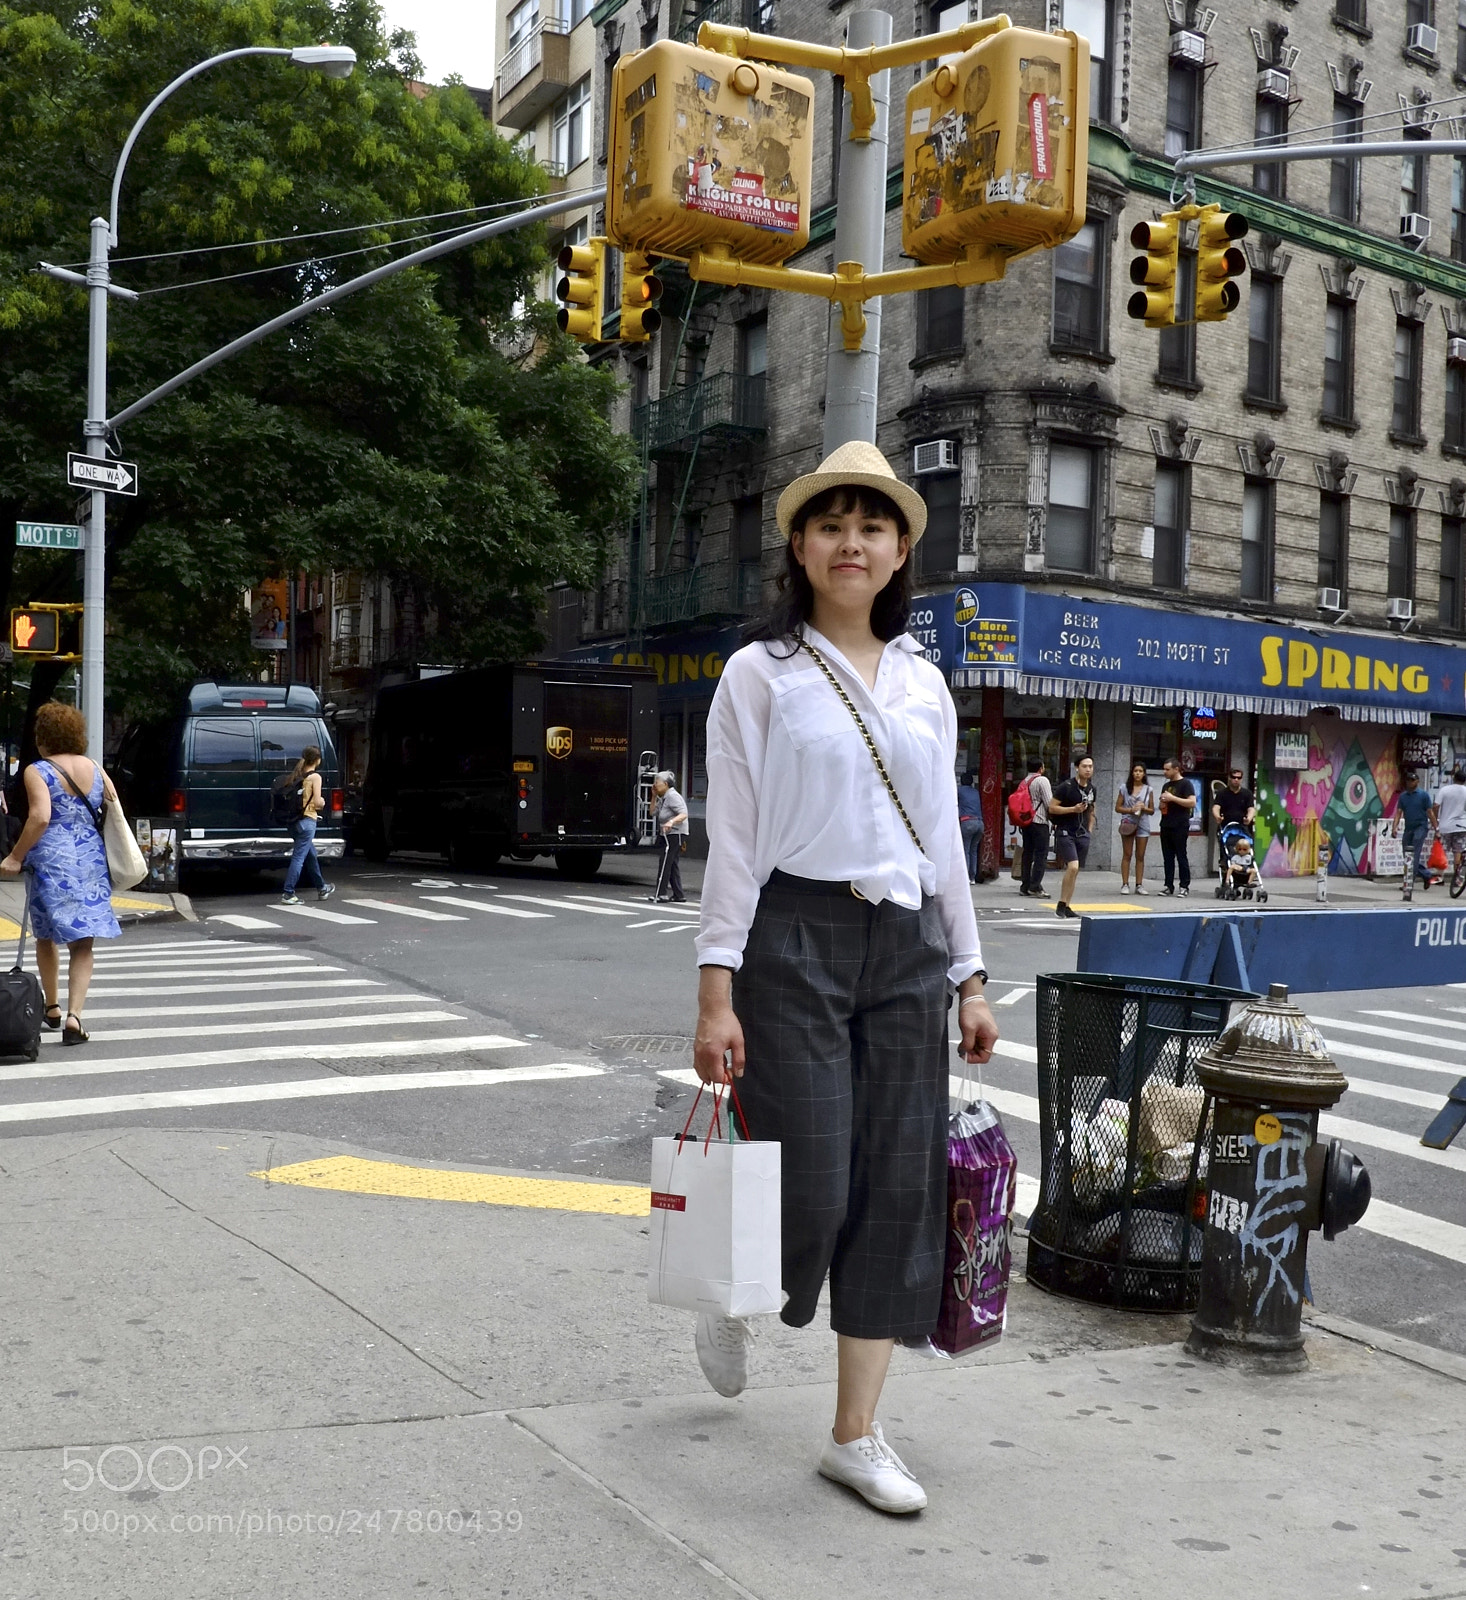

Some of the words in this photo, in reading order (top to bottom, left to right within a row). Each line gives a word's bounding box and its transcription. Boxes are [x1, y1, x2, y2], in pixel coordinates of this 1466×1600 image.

[1032, 98, 1047, 174] SPRAYGROUND
[688, 196, 724, 209] PLANNED
[745, 195, 771, 210] FOR
[774, 200, 798, 214] LIFE
[718, 209, 739, 220] AWAY
[740, 212, 760, 224] WITH
[78, 465, 98, 479] ONE
[106, 470, 126, 484] WAY
[19, 525, 63, 545] MOTT
[65, 528, 78, 538] ST
[979, 621, 1008, 631] More
[1063, 611, 1099, 629] BEER
[969, 631, 1017, 642] Reasons
[1059, 631, 1101, 650] SODA
[978, 642, 994, 651] To
[1137, 638, 1160, 659] 202
[1166, 641, 1208, 663] MOTT
[1213, 647, 1231, 666] ST
[993, 651, 1015, 662] York
[1039, 649, 1062, 665] ICE
[1069, 652, 1121, 670] CREAM
[1260, 635, 1429, 693] SPRING
[548, 736, 571, 754] ups
[1277, 732, 1306, 748] TUI-NA
